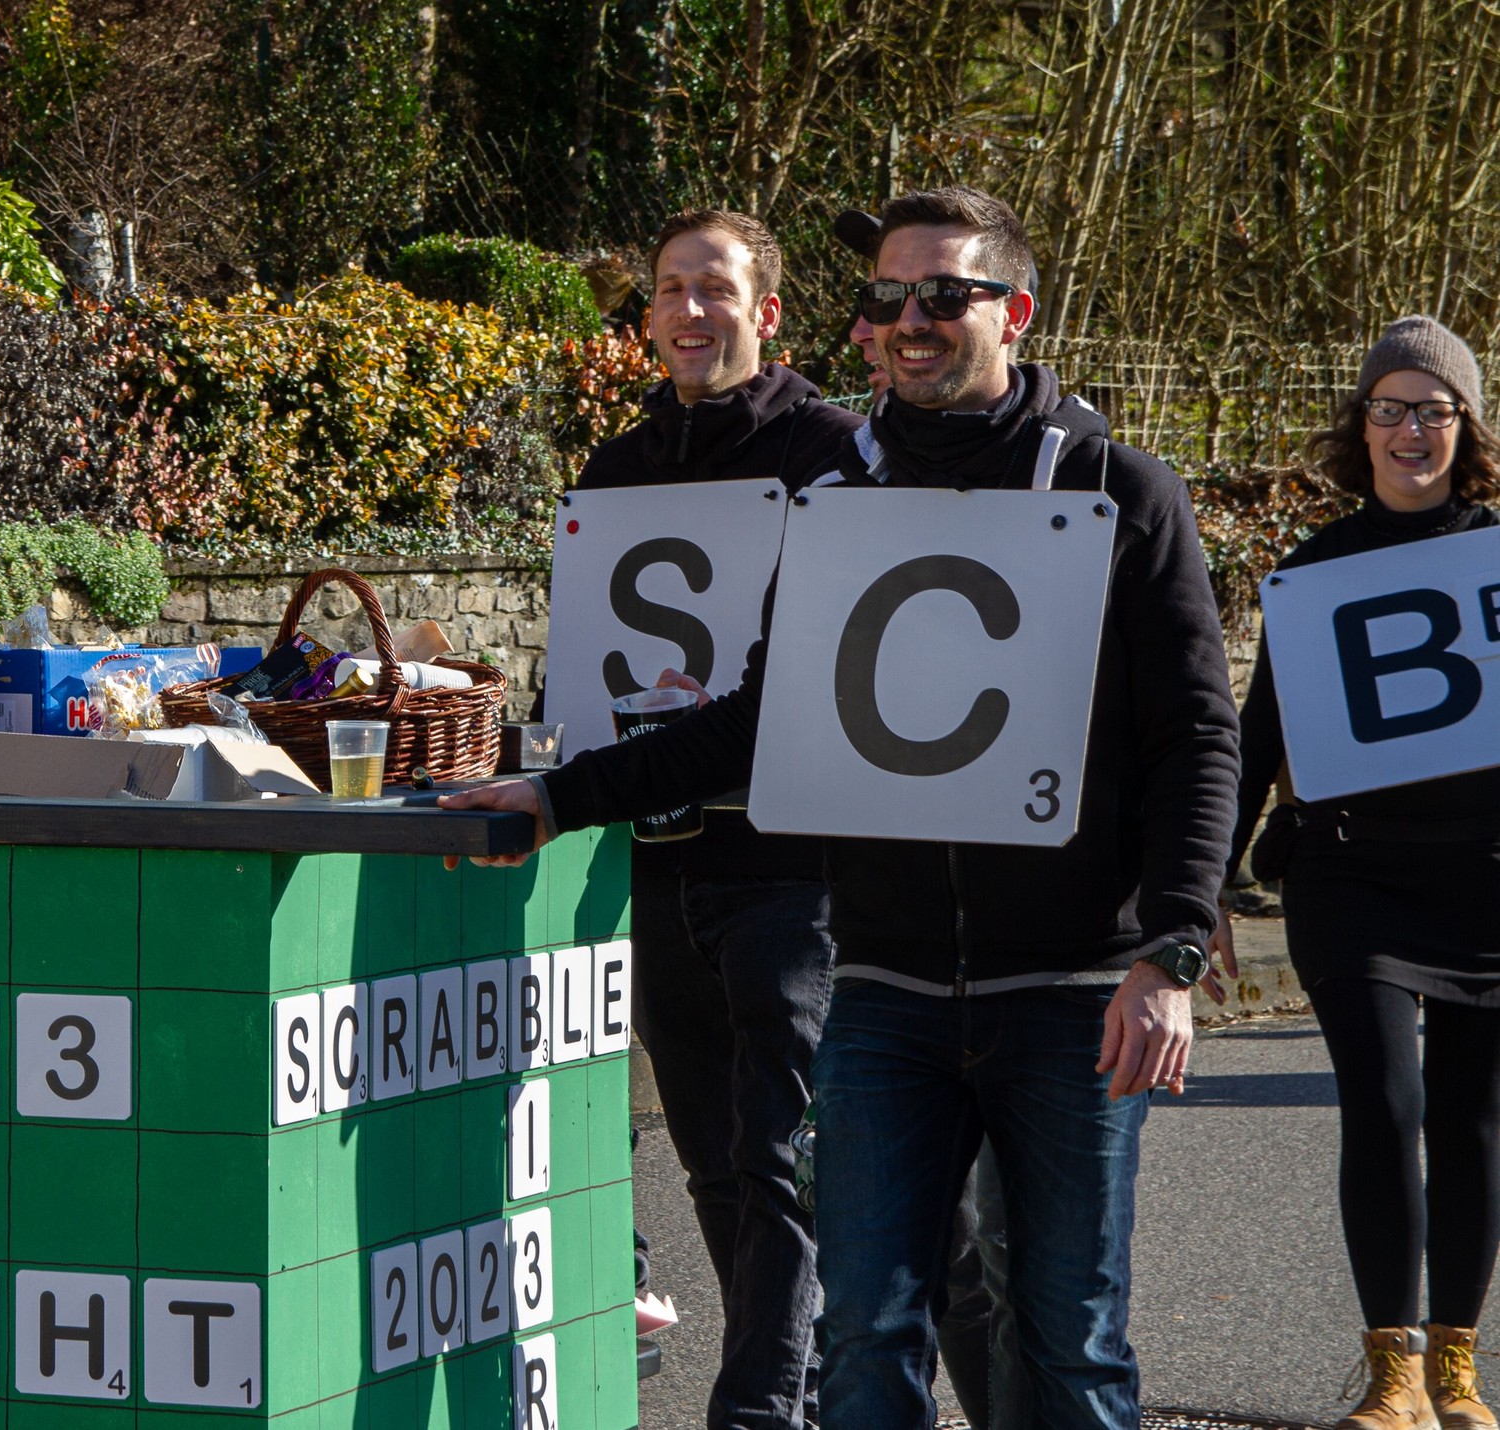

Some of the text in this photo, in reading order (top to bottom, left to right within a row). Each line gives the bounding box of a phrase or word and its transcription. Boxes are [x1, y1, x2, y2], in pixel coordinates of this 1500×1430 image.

[602, 537, 714, 698] S
[835, 555, 1020, 776] C
[1024, 769, 1060, 823] 3
[288, 960, 622, 1103] SCRABBLE
